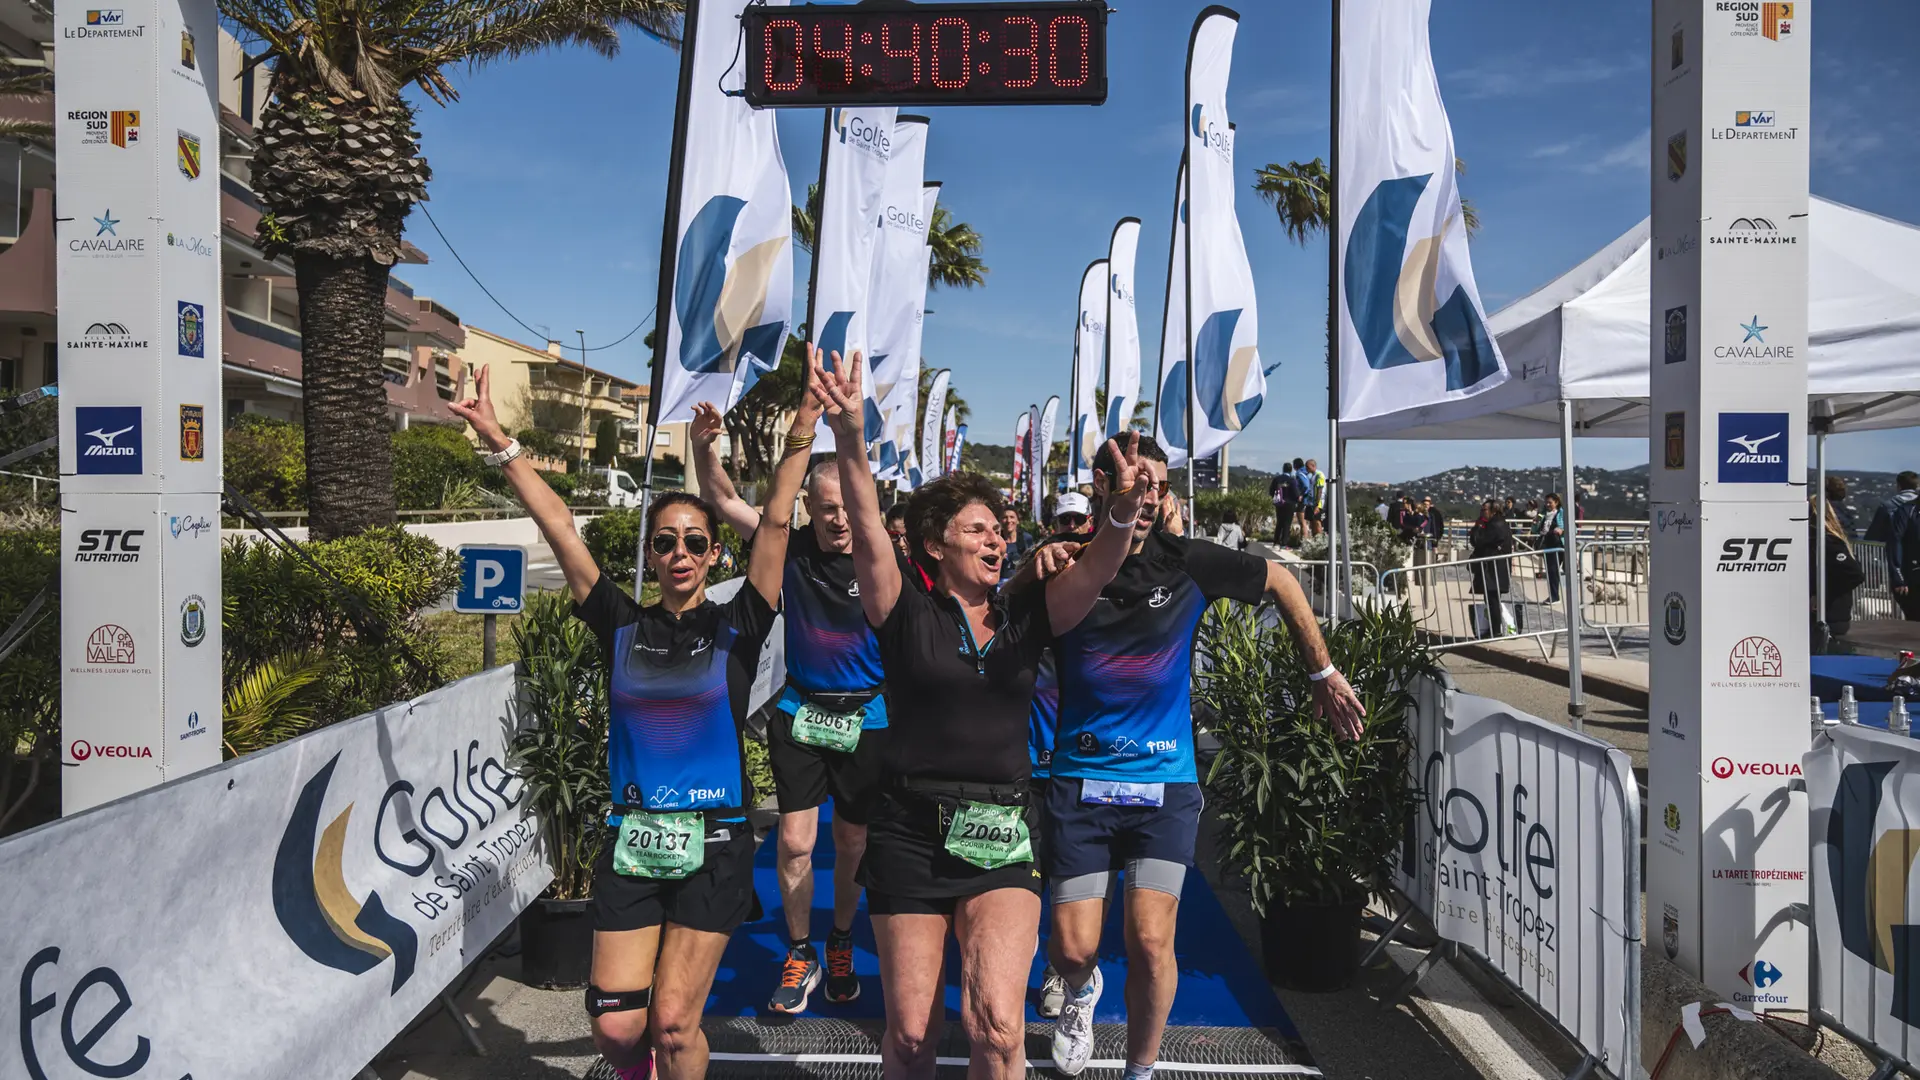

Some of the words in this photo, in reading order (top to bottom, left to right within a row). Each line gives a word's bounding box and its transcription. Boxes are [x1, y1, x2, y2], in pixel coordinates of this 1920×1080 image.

[1736, 12, 1759, 22] SUD
[764, 15, 1088, 92] 04:40:30
[86, 121, 108, 130] SUD
[850, 116, 890, 152] Golfe
[886, 205, 924, 230] Golfe
[70, 239, 145, 252] CAVALAIRE
[175, 238, 185, 247] LA
[67, 340, 149, 350] SAINTE-MAXIME
[1714, 346, 1794, 358] CAVALAIRE
[78, 530, 144, 551] STC
[1720, 538, 1792, 560] STC
[74, 553, 139, 562] NUTRITION
[1716, 562, 1786, 572] NUTRITION
[474, 560, 504, 600] P
[92, 625, 118, 646] LILY
[118, 634, 129, 642] OF
[117, 641, 133, 649] THE
[1735, 639, 1763, 659] LILY
[1763, 645, 1776, 654] OF
[88, 649, 134, 664] VALLEY
[1762, 652, 1780, 661] THE
[1730, 659, 1782, 677] VALLEY
[804, 710, 852, 732] 20061
[94, 746, 152, 758] VEOLIA
[1738, 763, 1802, 776] VEOLIA
[374, 739, 524, 878] Golfe
[1424, 750, 1556, 900] Golfe
[627, 829, 691, 851] 20137
[960, 840, 984, 849] COURIR
[985, 843, 1004, 852] POUR
[1713, 869, 1723, 879] LA
[1725, 869, 1749, 879] TARTE
[1750, 868, 1804, 880] TROPÉZIENNE
[411, 892, 449, 920] de
[429, 898, 481, 958] Territoire
[484, 852, 534, 906] d'exception
[1486, 912, 1556, 987] d'exception
[1733, 992, 1789, 1004] Carrefour
